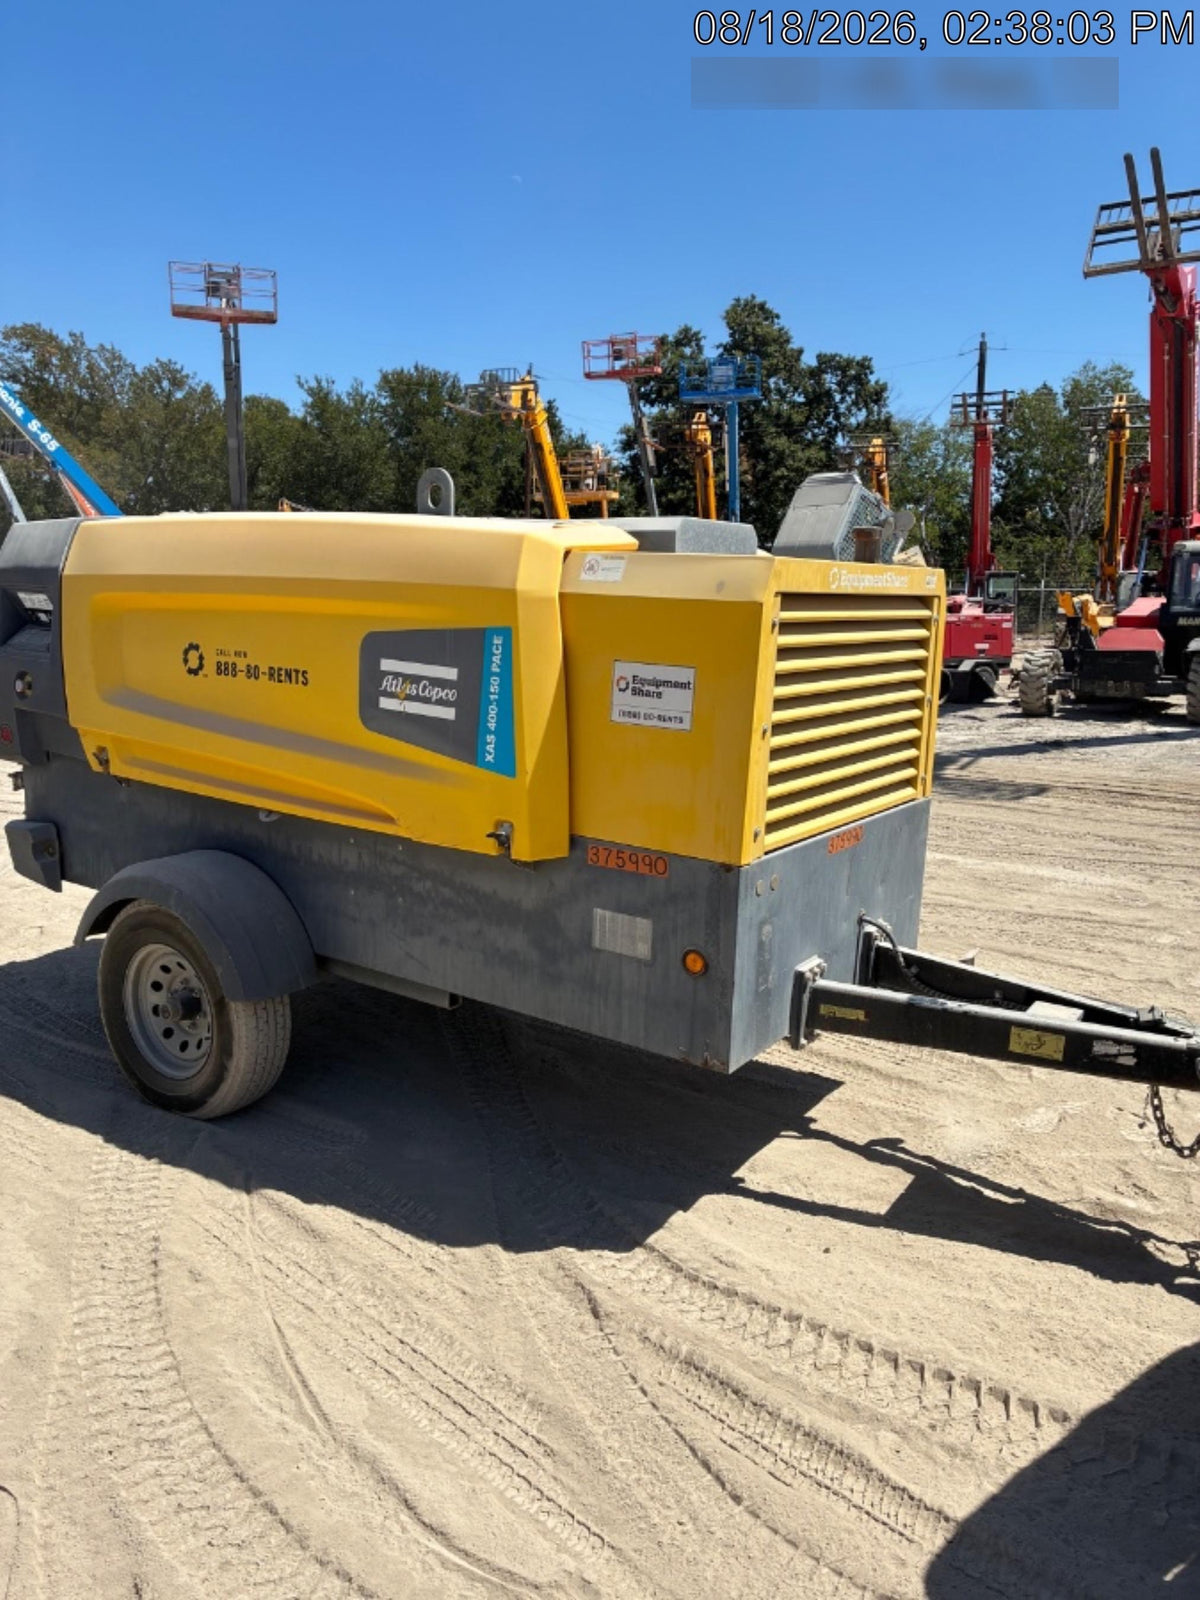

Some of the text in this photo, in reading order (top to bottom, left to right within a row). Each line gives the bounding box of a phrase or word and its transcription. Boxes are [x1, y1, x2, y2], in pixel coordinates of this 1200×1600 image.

[28, 419, 60, 452] S-65
[216, 660, 309, 686] 888-80-RENTS
[632, 675, 692, 691] Equipment
[419, 680, 458, 703] Copco
[485, 635, 503, 763] XAS 400-150 PACE
[631, 686, 662, 700] Share
[589, 845, 668, 876] 375990
